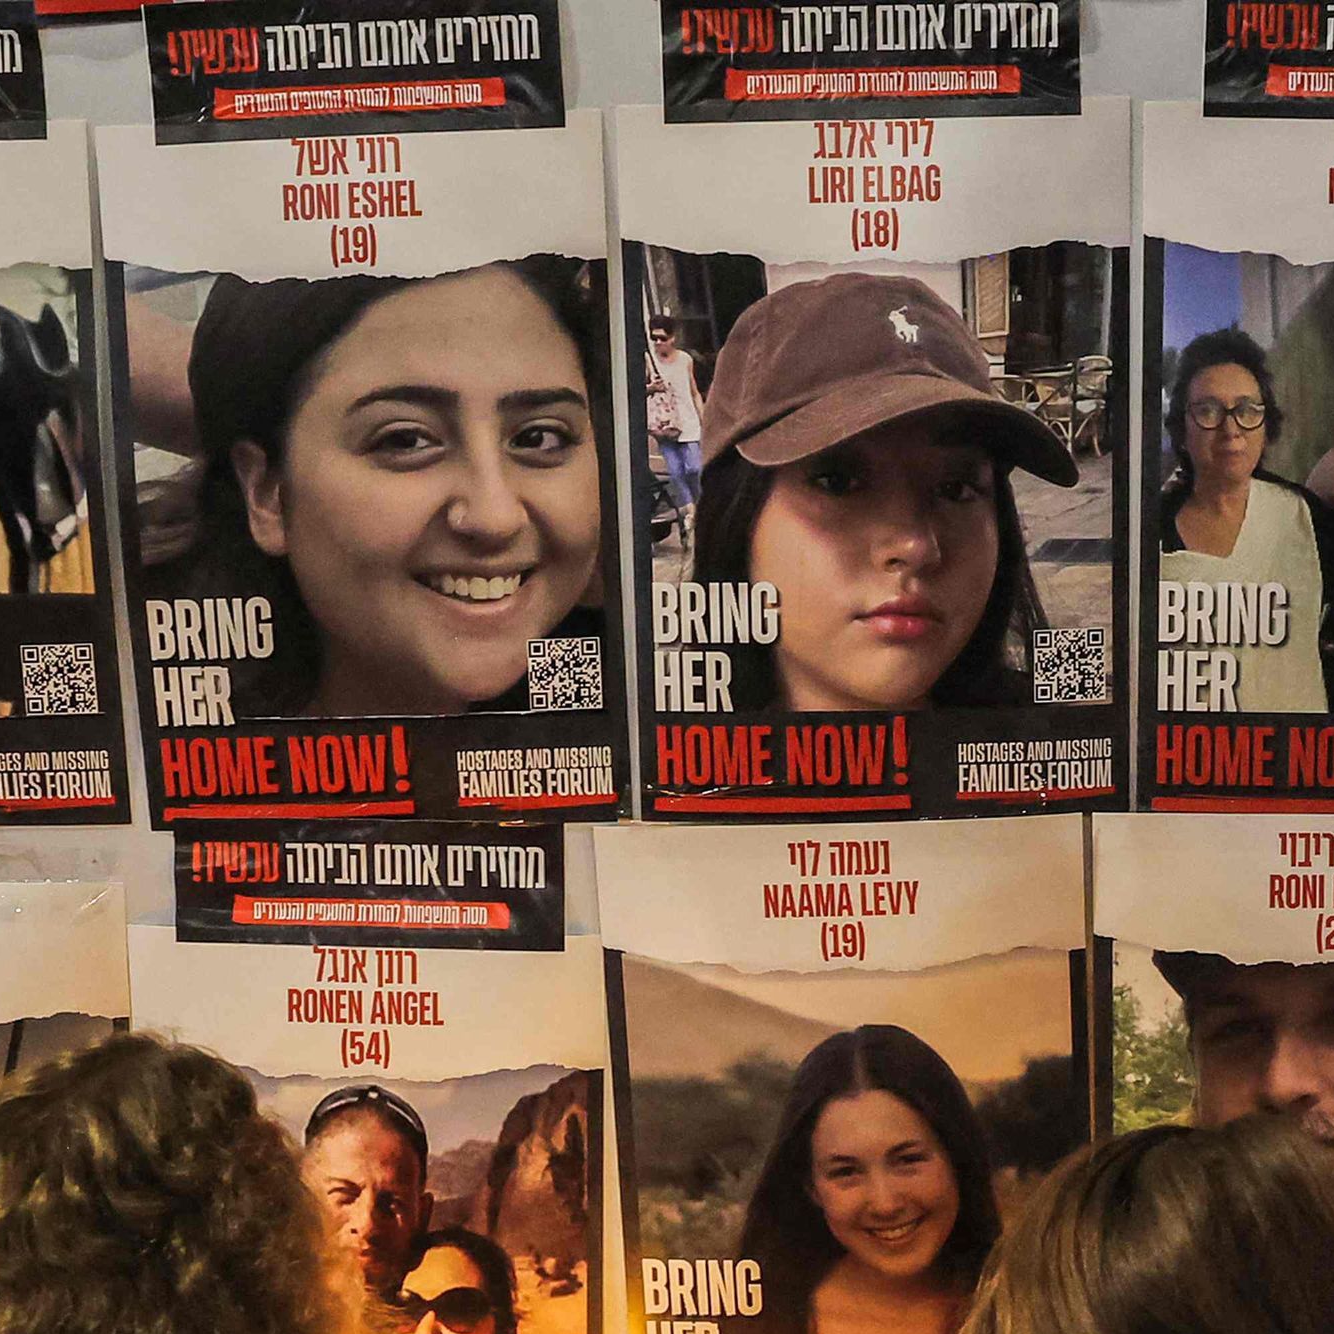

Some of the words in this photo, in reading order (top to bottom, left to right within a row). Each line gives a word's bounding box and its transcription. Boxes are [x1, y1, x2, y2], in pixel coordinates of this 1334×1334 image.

[357, 136, 401, 173] רוני
[815, 120, 875, 159] אלבג
[886, 119, 934, 156] לירי
[291, 138, 349, 177] אשל
[283, 183, 341, 221] RONI
[348, 180, 422, 219] ESHEL
[809, 167, 854, 203] LIRI
[864, 165, 942, 203] ELBAG
[332, 225, 377, 266] (19)
[852, 209, 900, 251] (18)
[652, 581, 779, 644] BRING
[654, 650, 733, 712] HER
[24, 752, 49, 771] AND
[52, 750, 108, 770] MISSING
[657, 725, 774, 785] HOME
[787, 716, 907, 785] NOW!
[958, 742, 1024, 762] HOSTAGES
[1027, 741, 1052, 760] AND
[1056, 738, 1111, 759] MISSING
[45, 771, 112, 799] FORUM
[959, 763, 1045, 792] FAMILIES
[1048, 759, 1111, 790] FORUM
[193, 842, 281, 883] עכשיו!
[285, 843, 367, 884] הביתה
[374, 844, 441, 886] אותם
[447, 846, 545, 888] מחזירים
[789, 840, 820, 876] לוי
[829, 840, 891, 876] נעמה
[764, 883, 854, 918] NAAMA
[861, 881, 918, 916] LEVY
[1270, 874, 1325, 909] RONI
[822, 921, 866, 960] (19)
[314, 945, 367, 983] אנגל
[376, 950, 418, 988] רונן
[289, 988, 363, 1024] RONEN
[371, 991, 444, 1026] ANGEL
[342, 1030, 390, 1067] (54)
[642, 1258, 762, 1316] BRING
